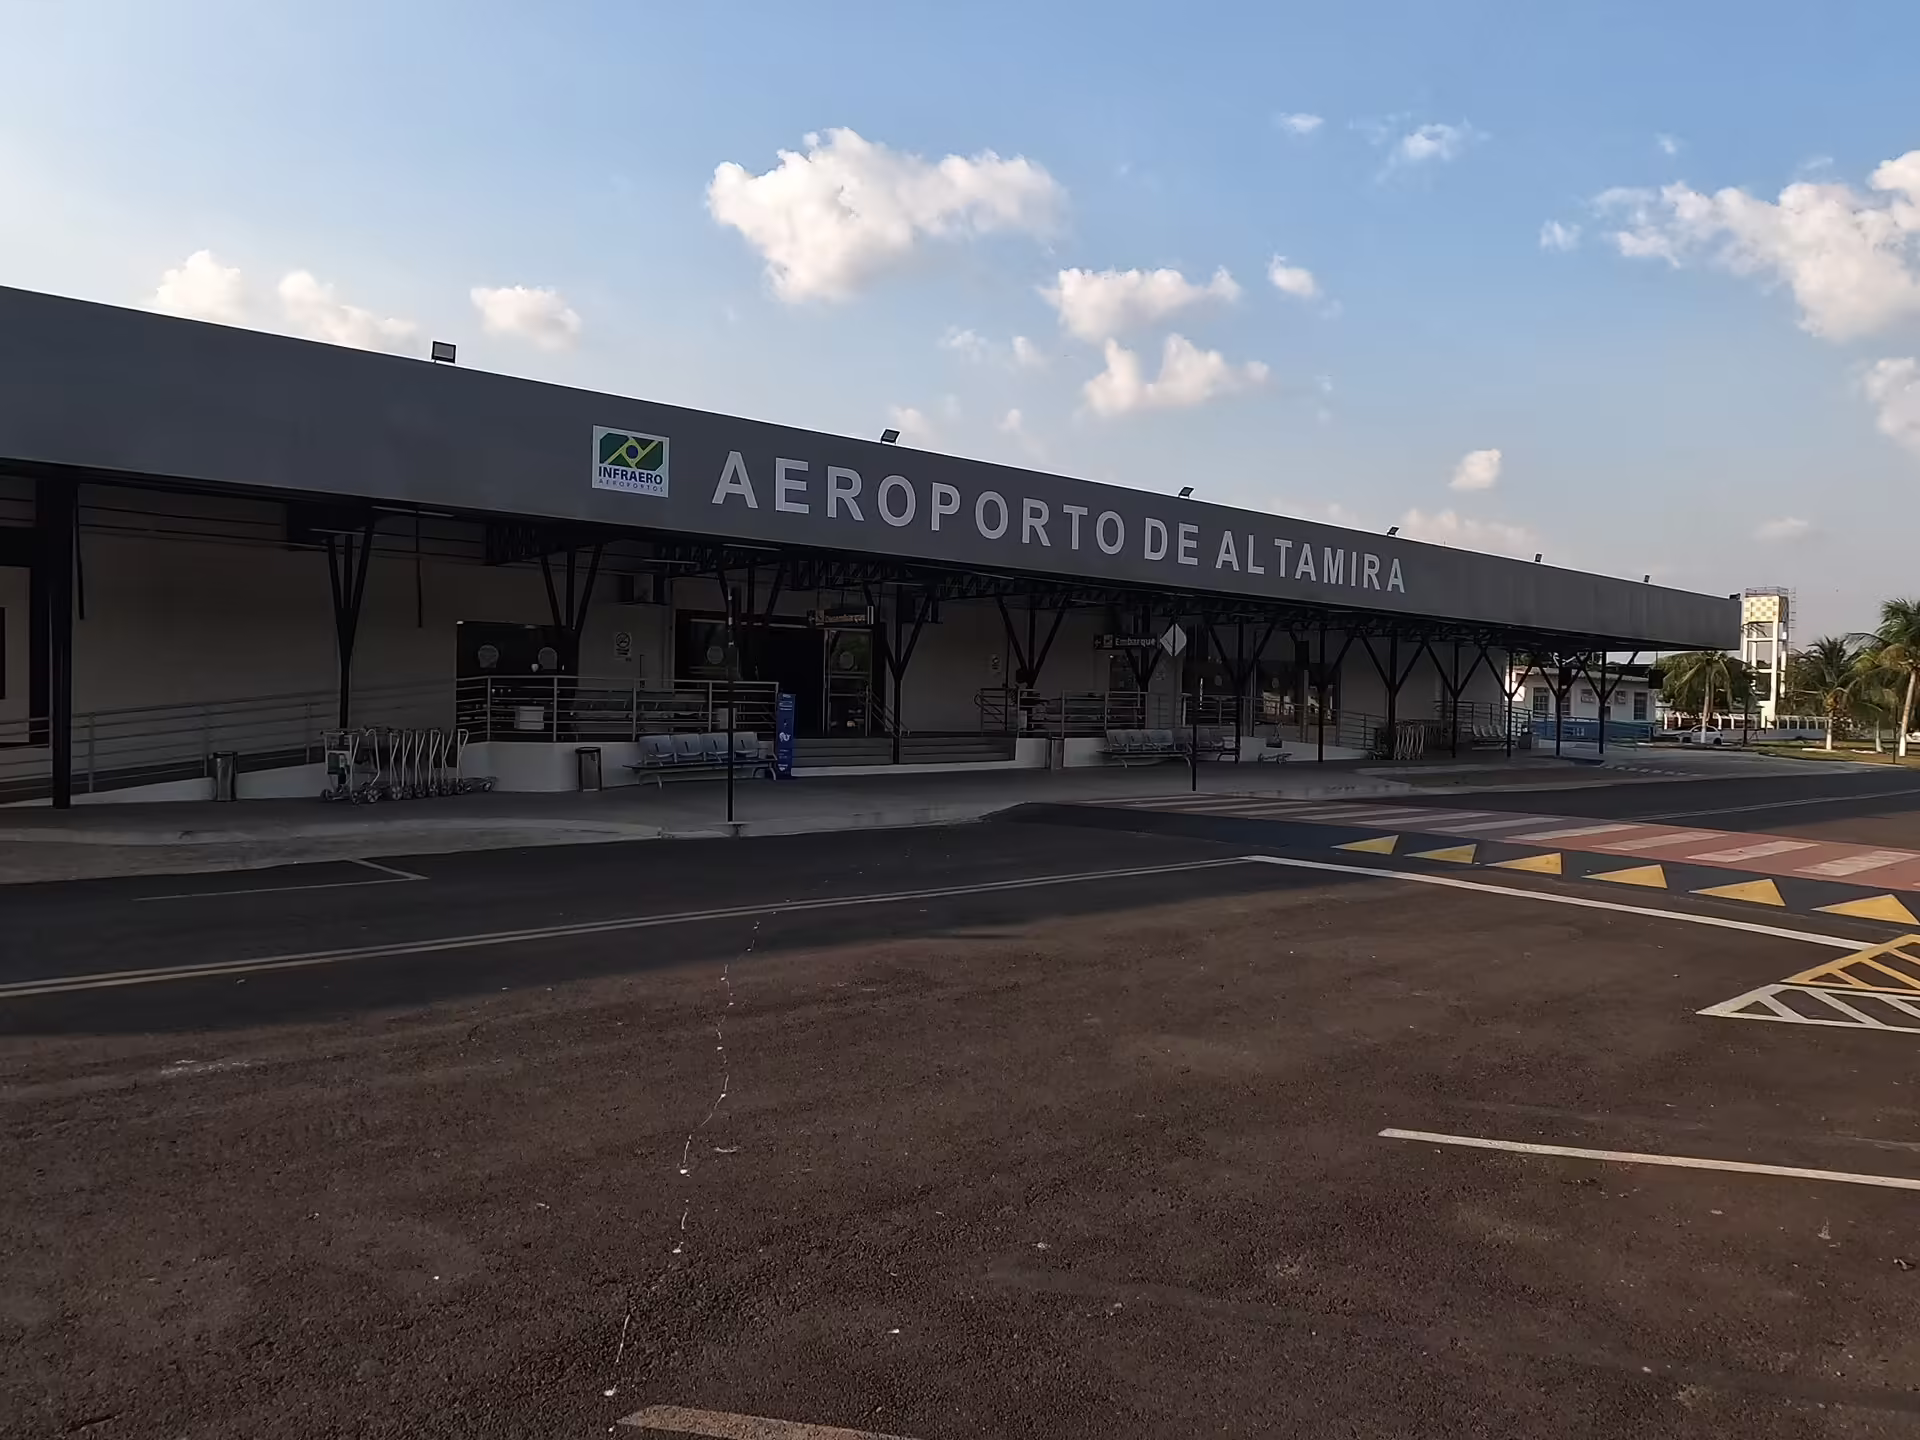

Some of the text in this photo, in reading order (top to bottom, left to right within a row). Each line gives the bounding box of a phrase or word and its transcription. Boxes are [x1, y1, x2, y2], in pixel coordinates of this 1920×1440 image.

[598, 466, 663, 485] INFRAERO
[598, 479, 664, 493] AEROPORTOS
[712, 450, 1406, 593] AEROPORTO DE ALTAMIRA
